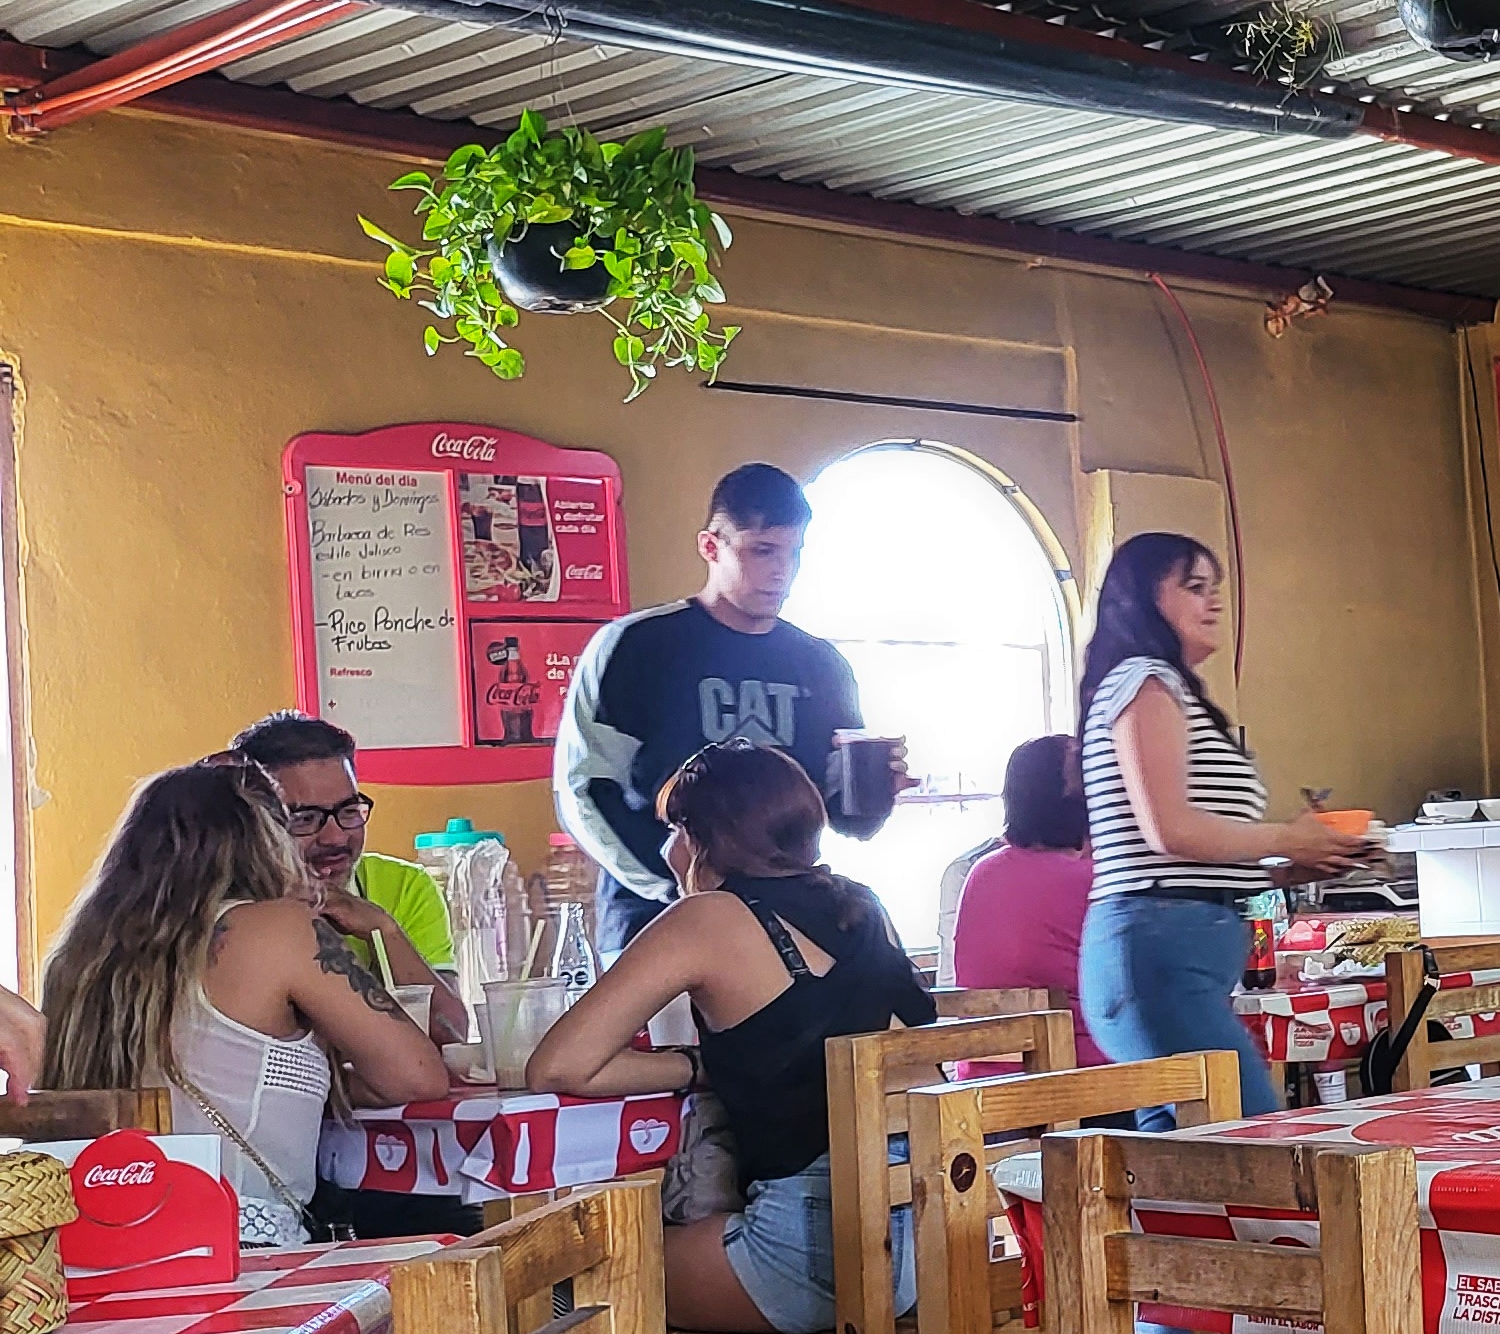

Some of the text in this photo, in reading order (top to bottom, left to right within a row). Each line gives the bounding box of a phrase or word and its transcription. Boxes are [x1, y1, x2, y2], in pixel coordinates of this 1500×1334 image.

[336, 471, 372, 485] Menú
[376, 474, 394, 486] del
[371, 494, 381, 513] y
[377, 525, 395, 540] de
[423, 565, 440, 574] en
[374, 606, 435, 633] Ponche
[439, 608, 455, 627] de
[331, 635, 392, 653] Frutas
[329, 667, 373, 677] Refresco
[698, 677, 800, 747] CAT
[1459, 1277, 1475, 1290] EL
[1453, 1307, 1469, 1321] LA
